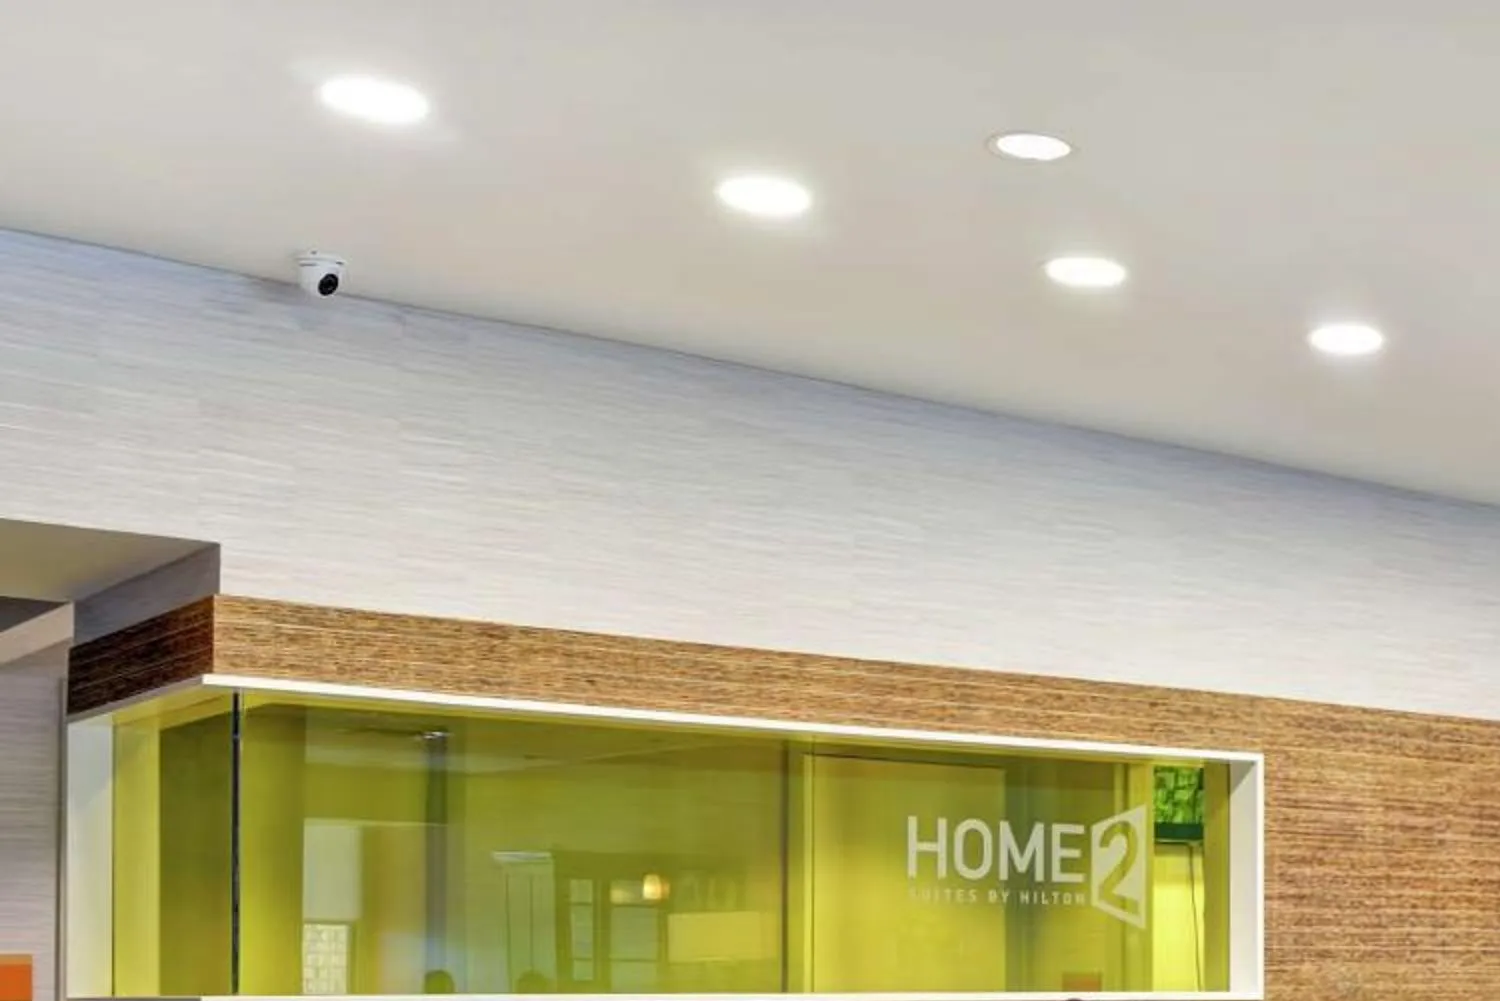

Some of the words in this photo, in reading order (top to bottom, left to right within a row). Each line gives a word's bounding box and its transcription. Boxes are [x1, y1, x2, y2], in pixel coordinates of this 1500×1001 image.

[908, 887, 977, 903] SUITES
[988, 889, 1010, 904] BY
[1020, 890, 1086, 906] HILTON
